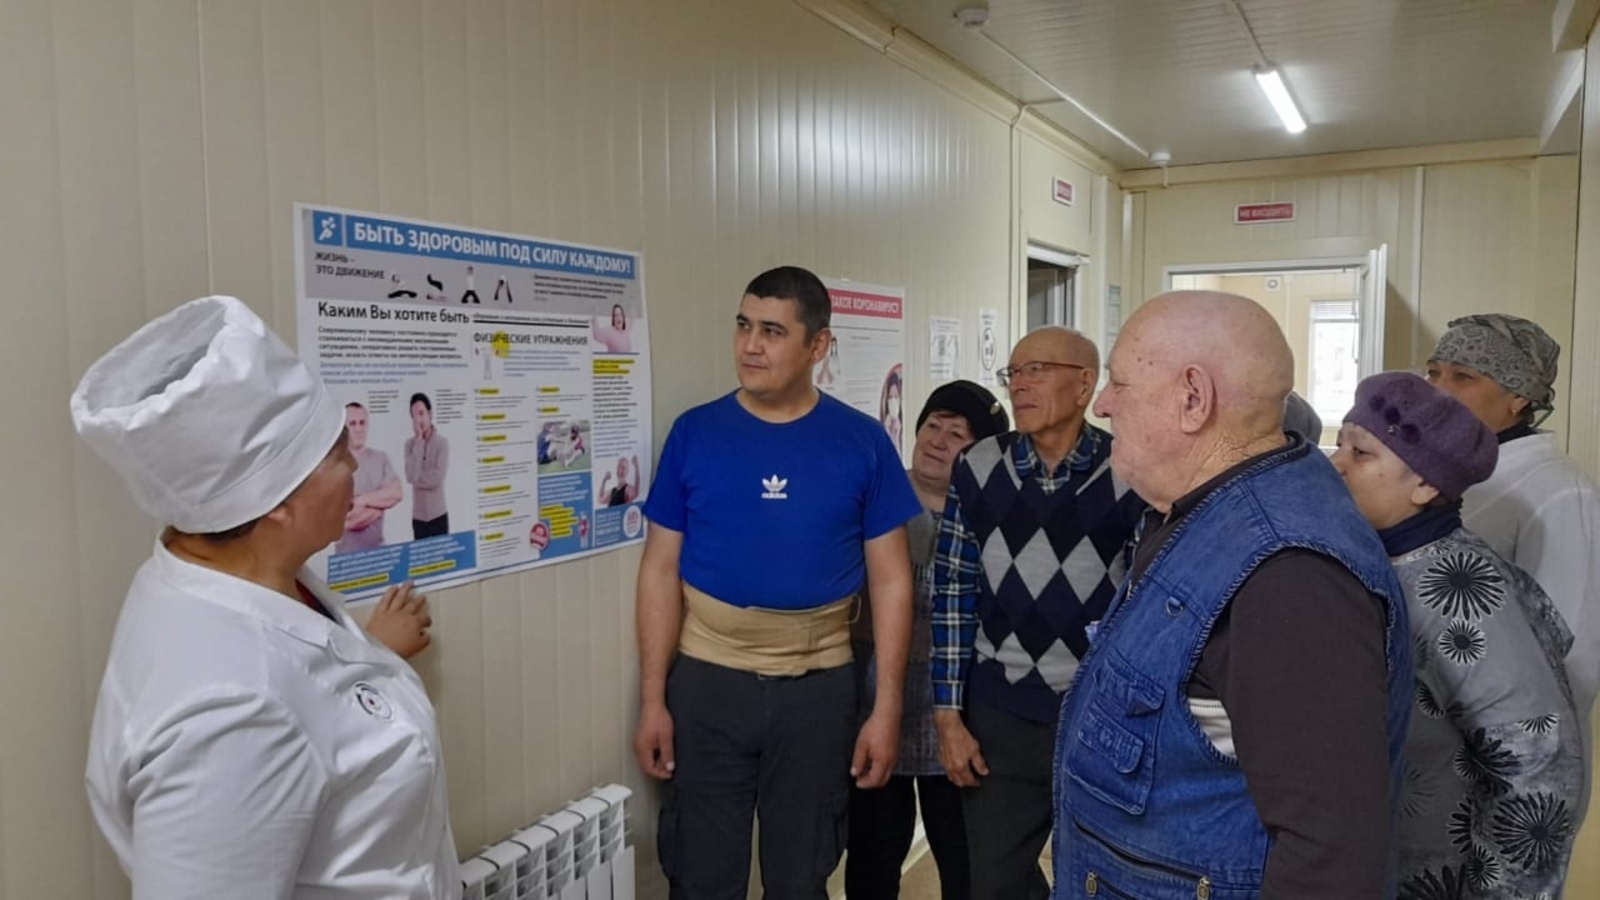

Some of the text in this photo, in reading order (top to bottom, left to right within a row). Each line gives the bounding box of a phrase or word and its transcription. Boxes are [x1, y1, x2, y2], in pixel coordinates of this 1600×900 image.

[354, 222, 631, 274] БЫТЬ ЗДОРОВЫМ ПОД СИЛУ КАЖДОМУ!
[315, 252, 349, 264] ЖИЗНЬ
[316, 265, 385, 280] ЭТО ДВИЖЕНИЕ
[318, 301, 367, 319] Каким
[370, 304, 391, 320] Вы
[394, 309, 437, 322] хотите
[439, 308, 470, 323] быть
[473, 332, 588, 346] ФИЗИЧЕСКИЕ УПРАЖНЕНИЯ
